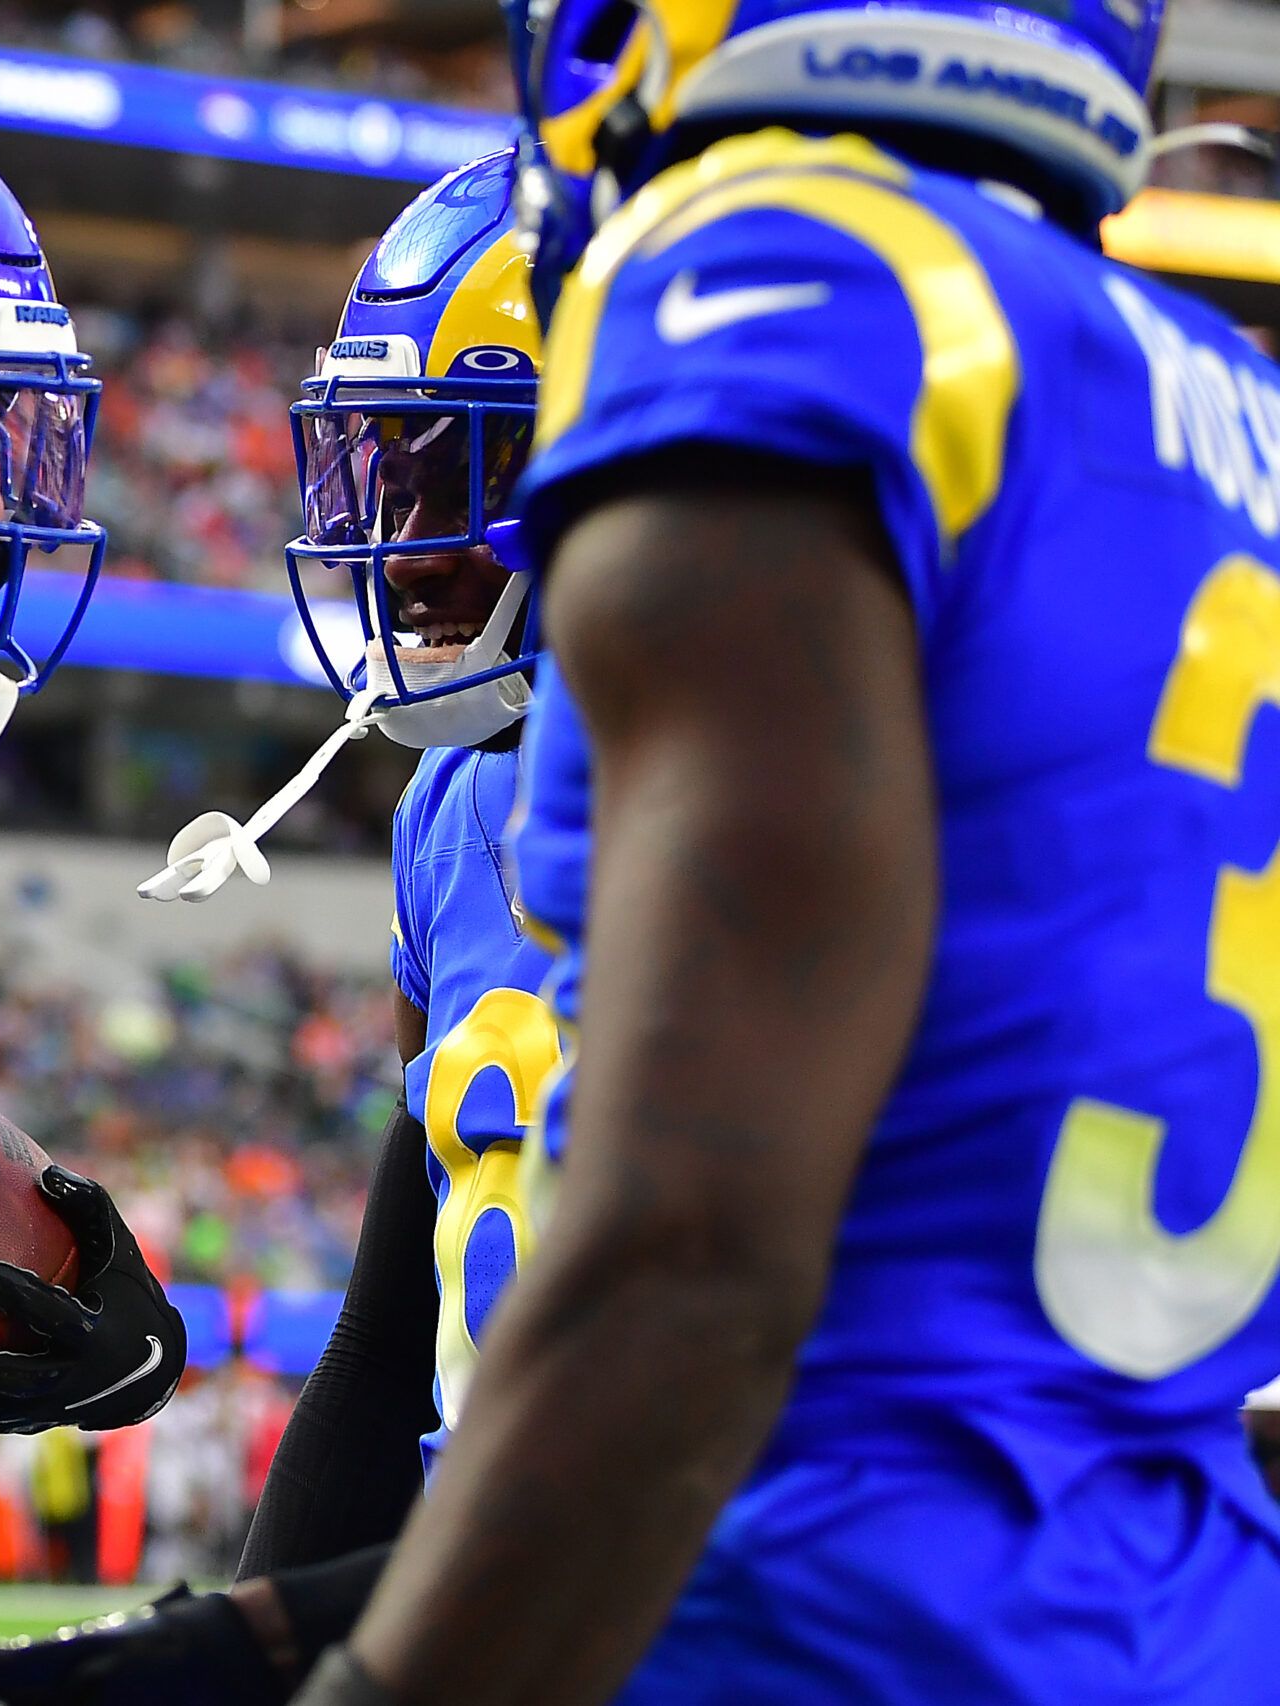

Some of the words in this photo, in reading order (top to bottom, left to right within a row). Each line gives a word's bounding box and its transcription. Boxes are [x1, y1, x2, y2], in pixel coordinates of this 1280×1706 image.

[802, 38, 919, 82] LOS
[15, 304, 69, 328] RAMS
[330, 339, 389, 361] RAMS
